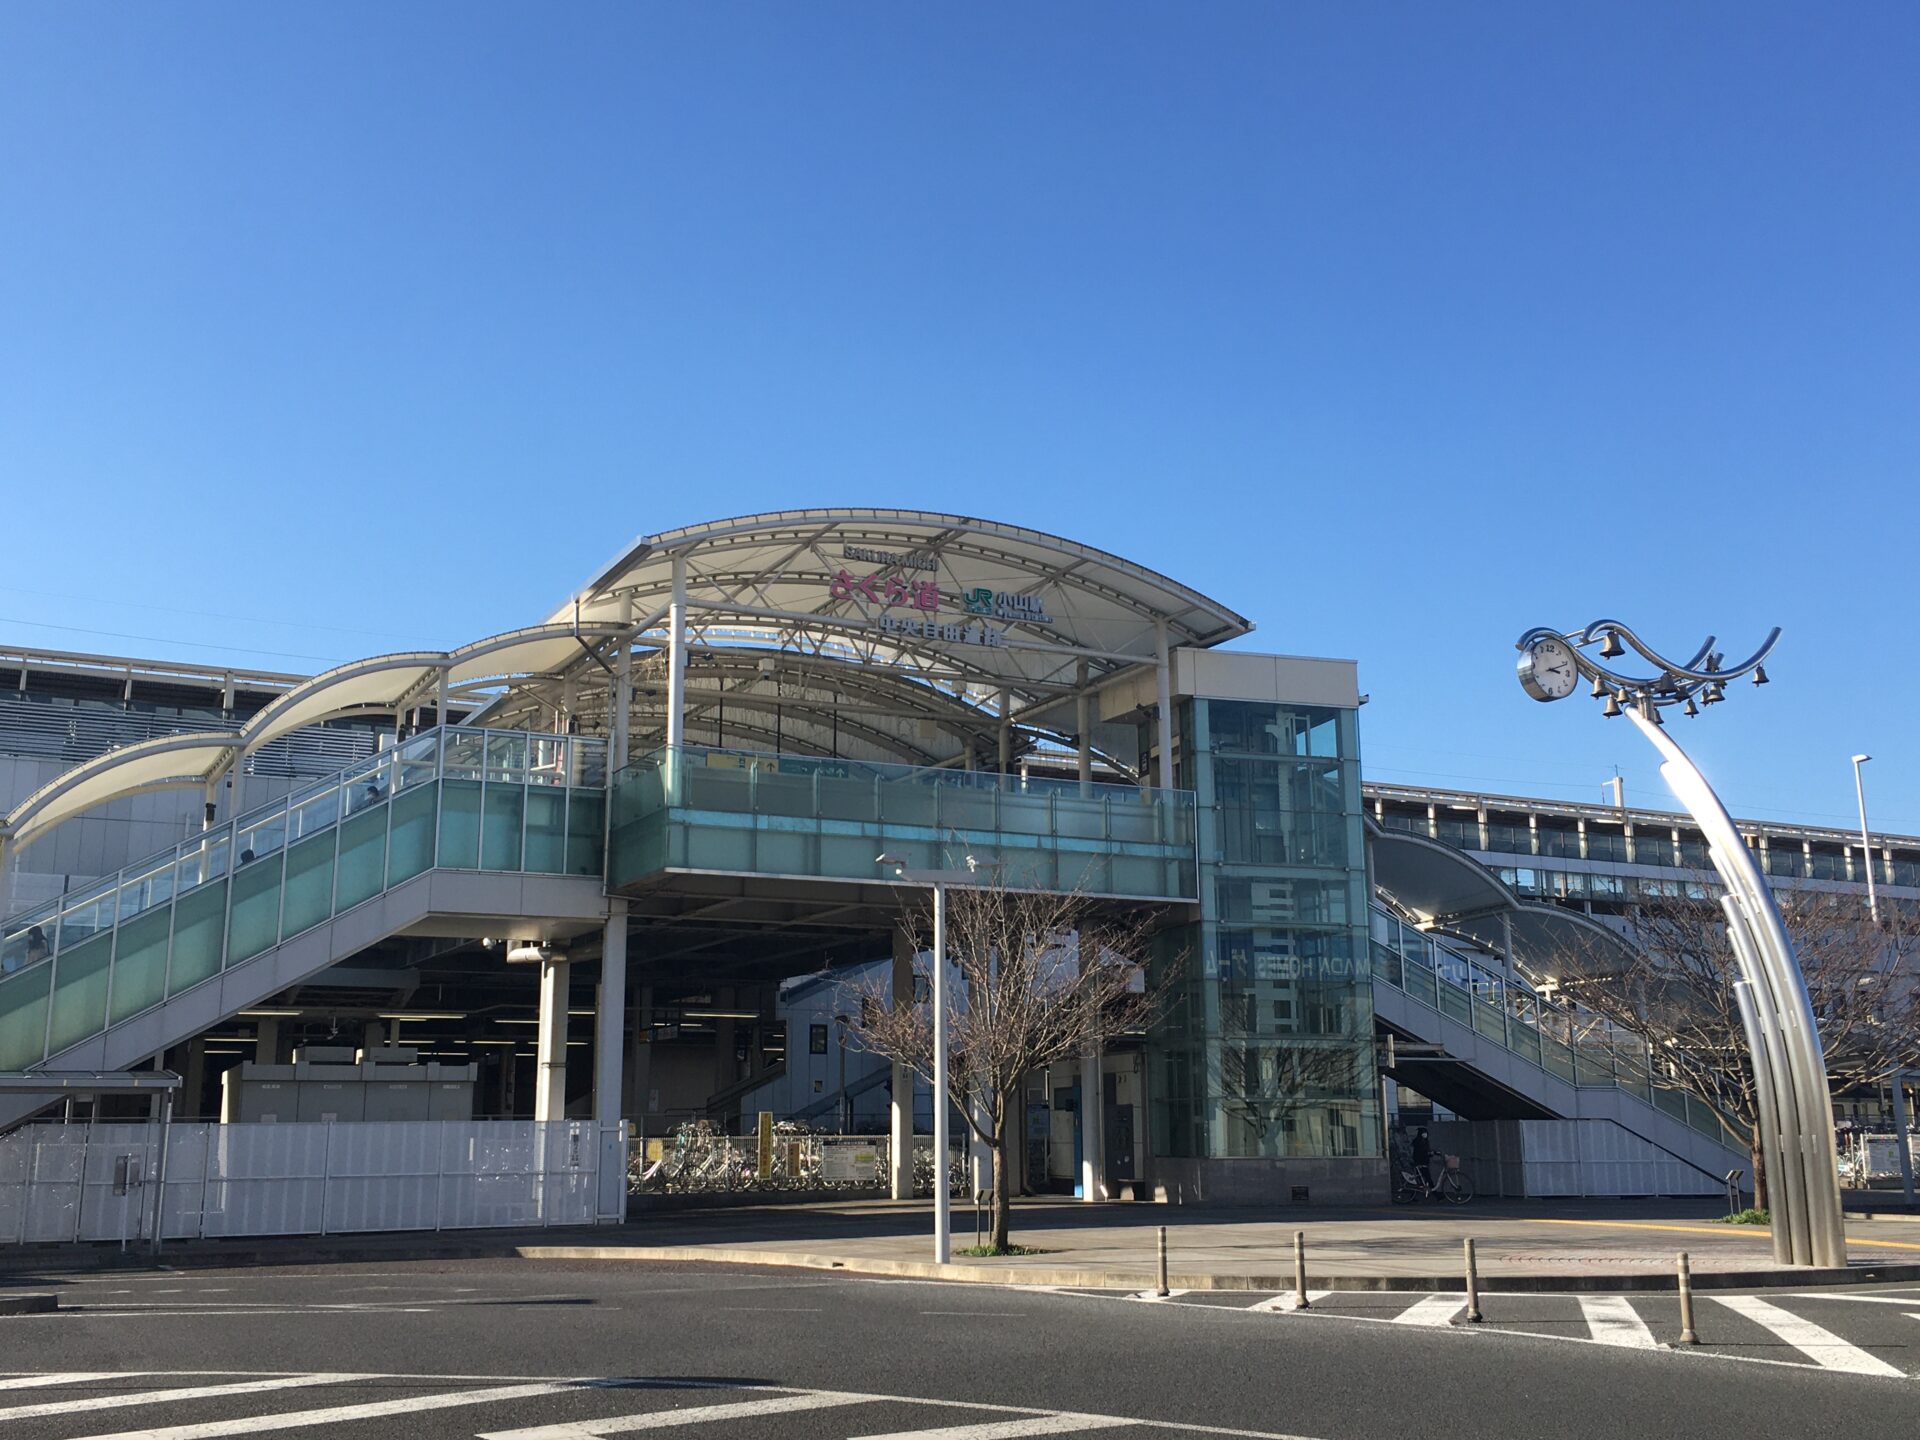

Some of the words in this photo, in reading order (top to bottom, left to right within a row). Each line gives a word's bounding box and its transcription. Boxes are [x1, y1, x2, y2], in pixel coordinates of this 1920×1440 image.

[831, 569, 940, 611] さくら道
[964, 588, 992, 607] JR
